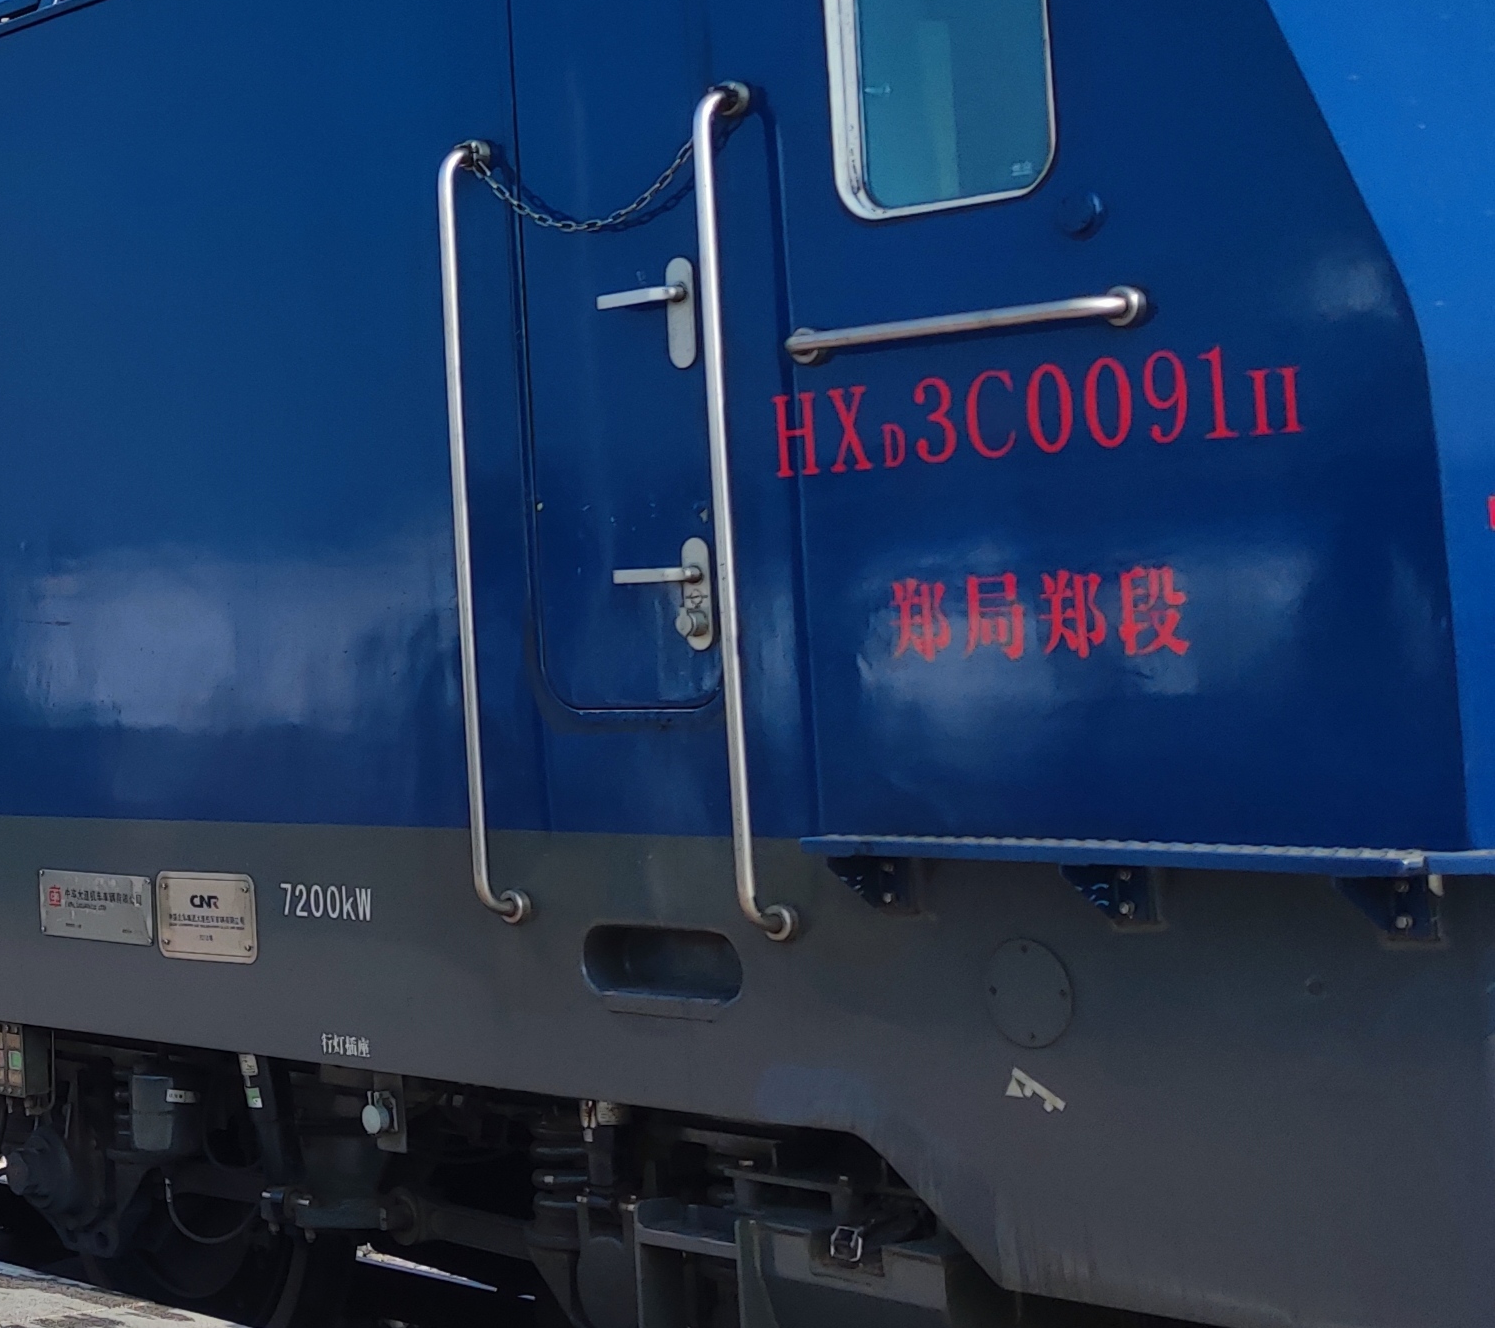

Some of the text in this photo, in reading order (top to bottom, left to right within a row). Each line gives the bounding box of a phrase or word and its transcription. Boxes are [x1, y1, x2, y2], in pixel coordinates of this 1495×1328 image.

[891, 566, 1191, 661] 郑局郑段
[190, 894, 219, 910] CNR
[280, 883, 372, 922] 7200kW
[320, 1033, 371, 1058] 行灯插座
